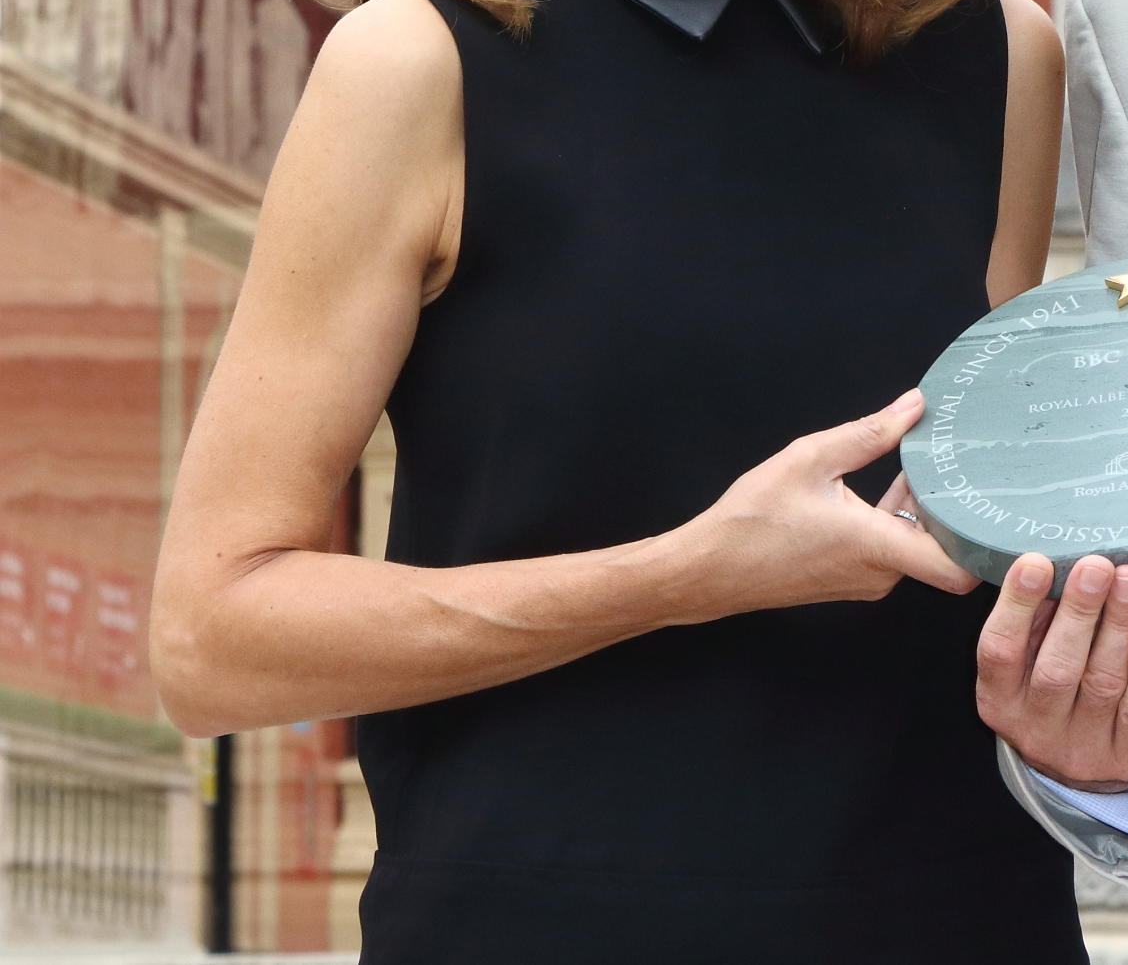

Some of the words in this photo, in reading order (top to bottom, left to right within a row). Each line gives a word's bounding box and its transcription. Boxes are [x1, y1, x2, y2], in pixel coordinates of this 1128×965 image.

[1019, 294, 1082, 329] 1941
[954, 331, 1020, 386] SINCE
[1073, 350, 1121, 369] BBC
[1029, 398, 1082, 414] ROYAL
[932, 391, 965, 474] FESTIVAL
[944, 475, 1012, 524] MUSIC
[1074, 483, 1115, 498] Royal
